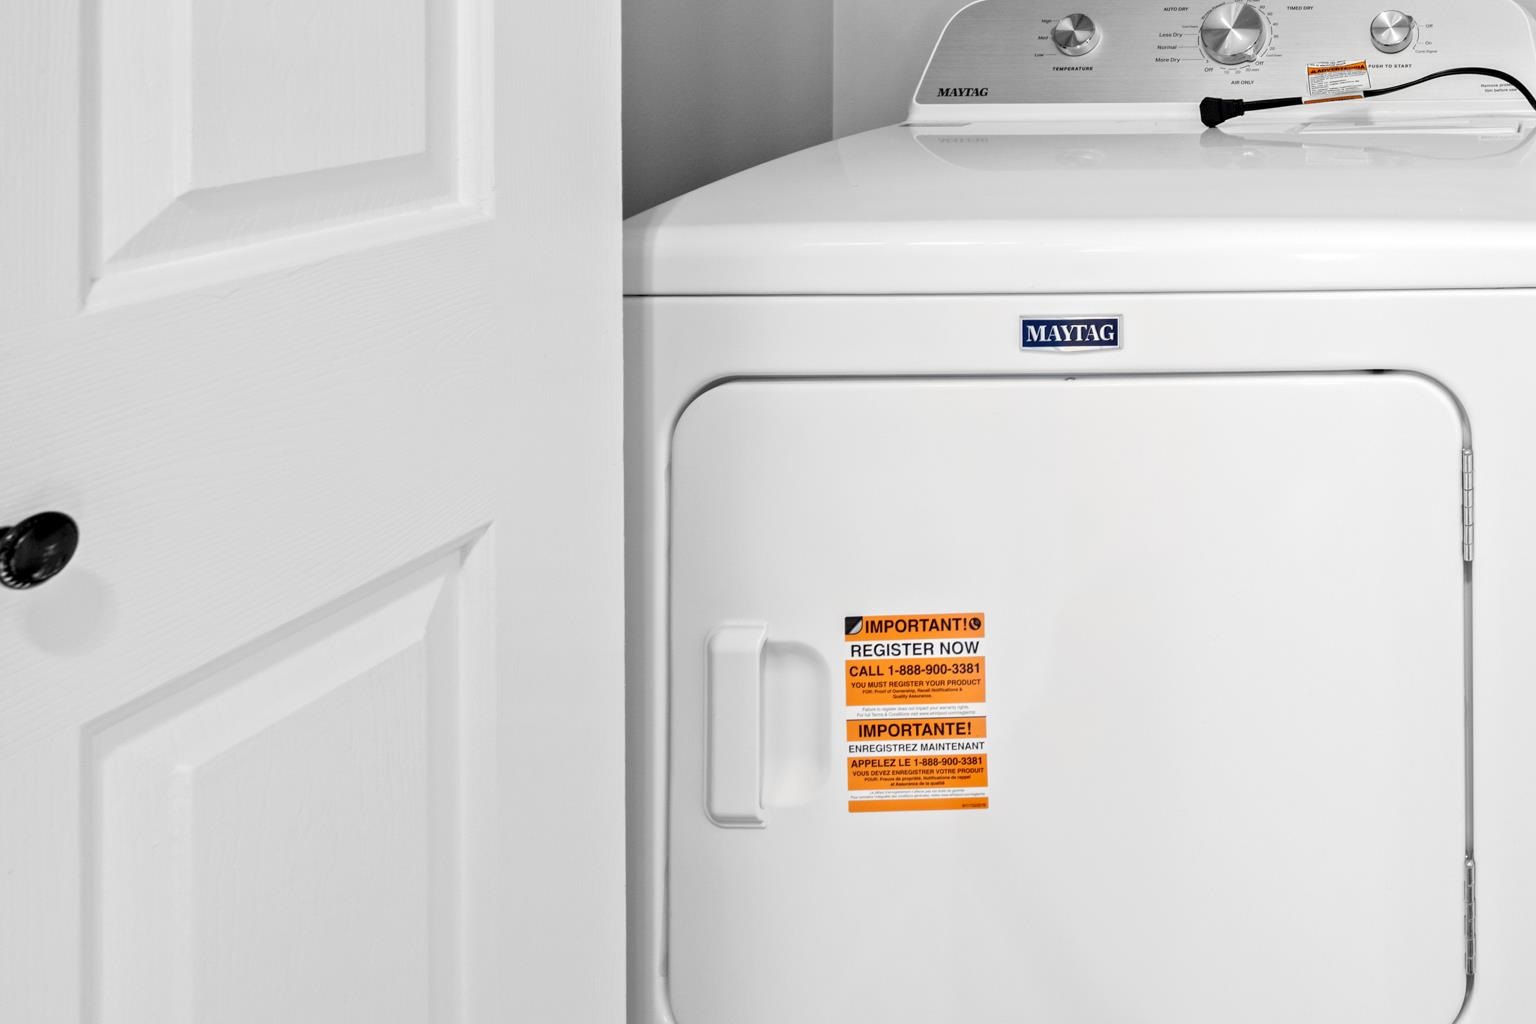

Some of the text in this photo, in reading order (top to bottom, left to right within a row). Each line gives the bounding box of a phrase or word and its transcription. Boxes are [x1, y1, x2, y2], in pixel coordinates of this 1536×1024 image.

[937, 87, 989, 97] MAYTAG
[1026, 324, 1115, 342] MAYTAG
[865, 618, 967, 633] IMPORTANT!
[851, 641, 980, 657] REGISTER NOW
[849, 663, 980, 677] CALL 1-888-900-3381
[858, 721, 971, 738] IMPORTANTE!
[848, 741, 985, 753] ENREGISTREZ MAINTENANT
[851, 756, 982, 768] APPELEZ LE 1-888-900-3381
